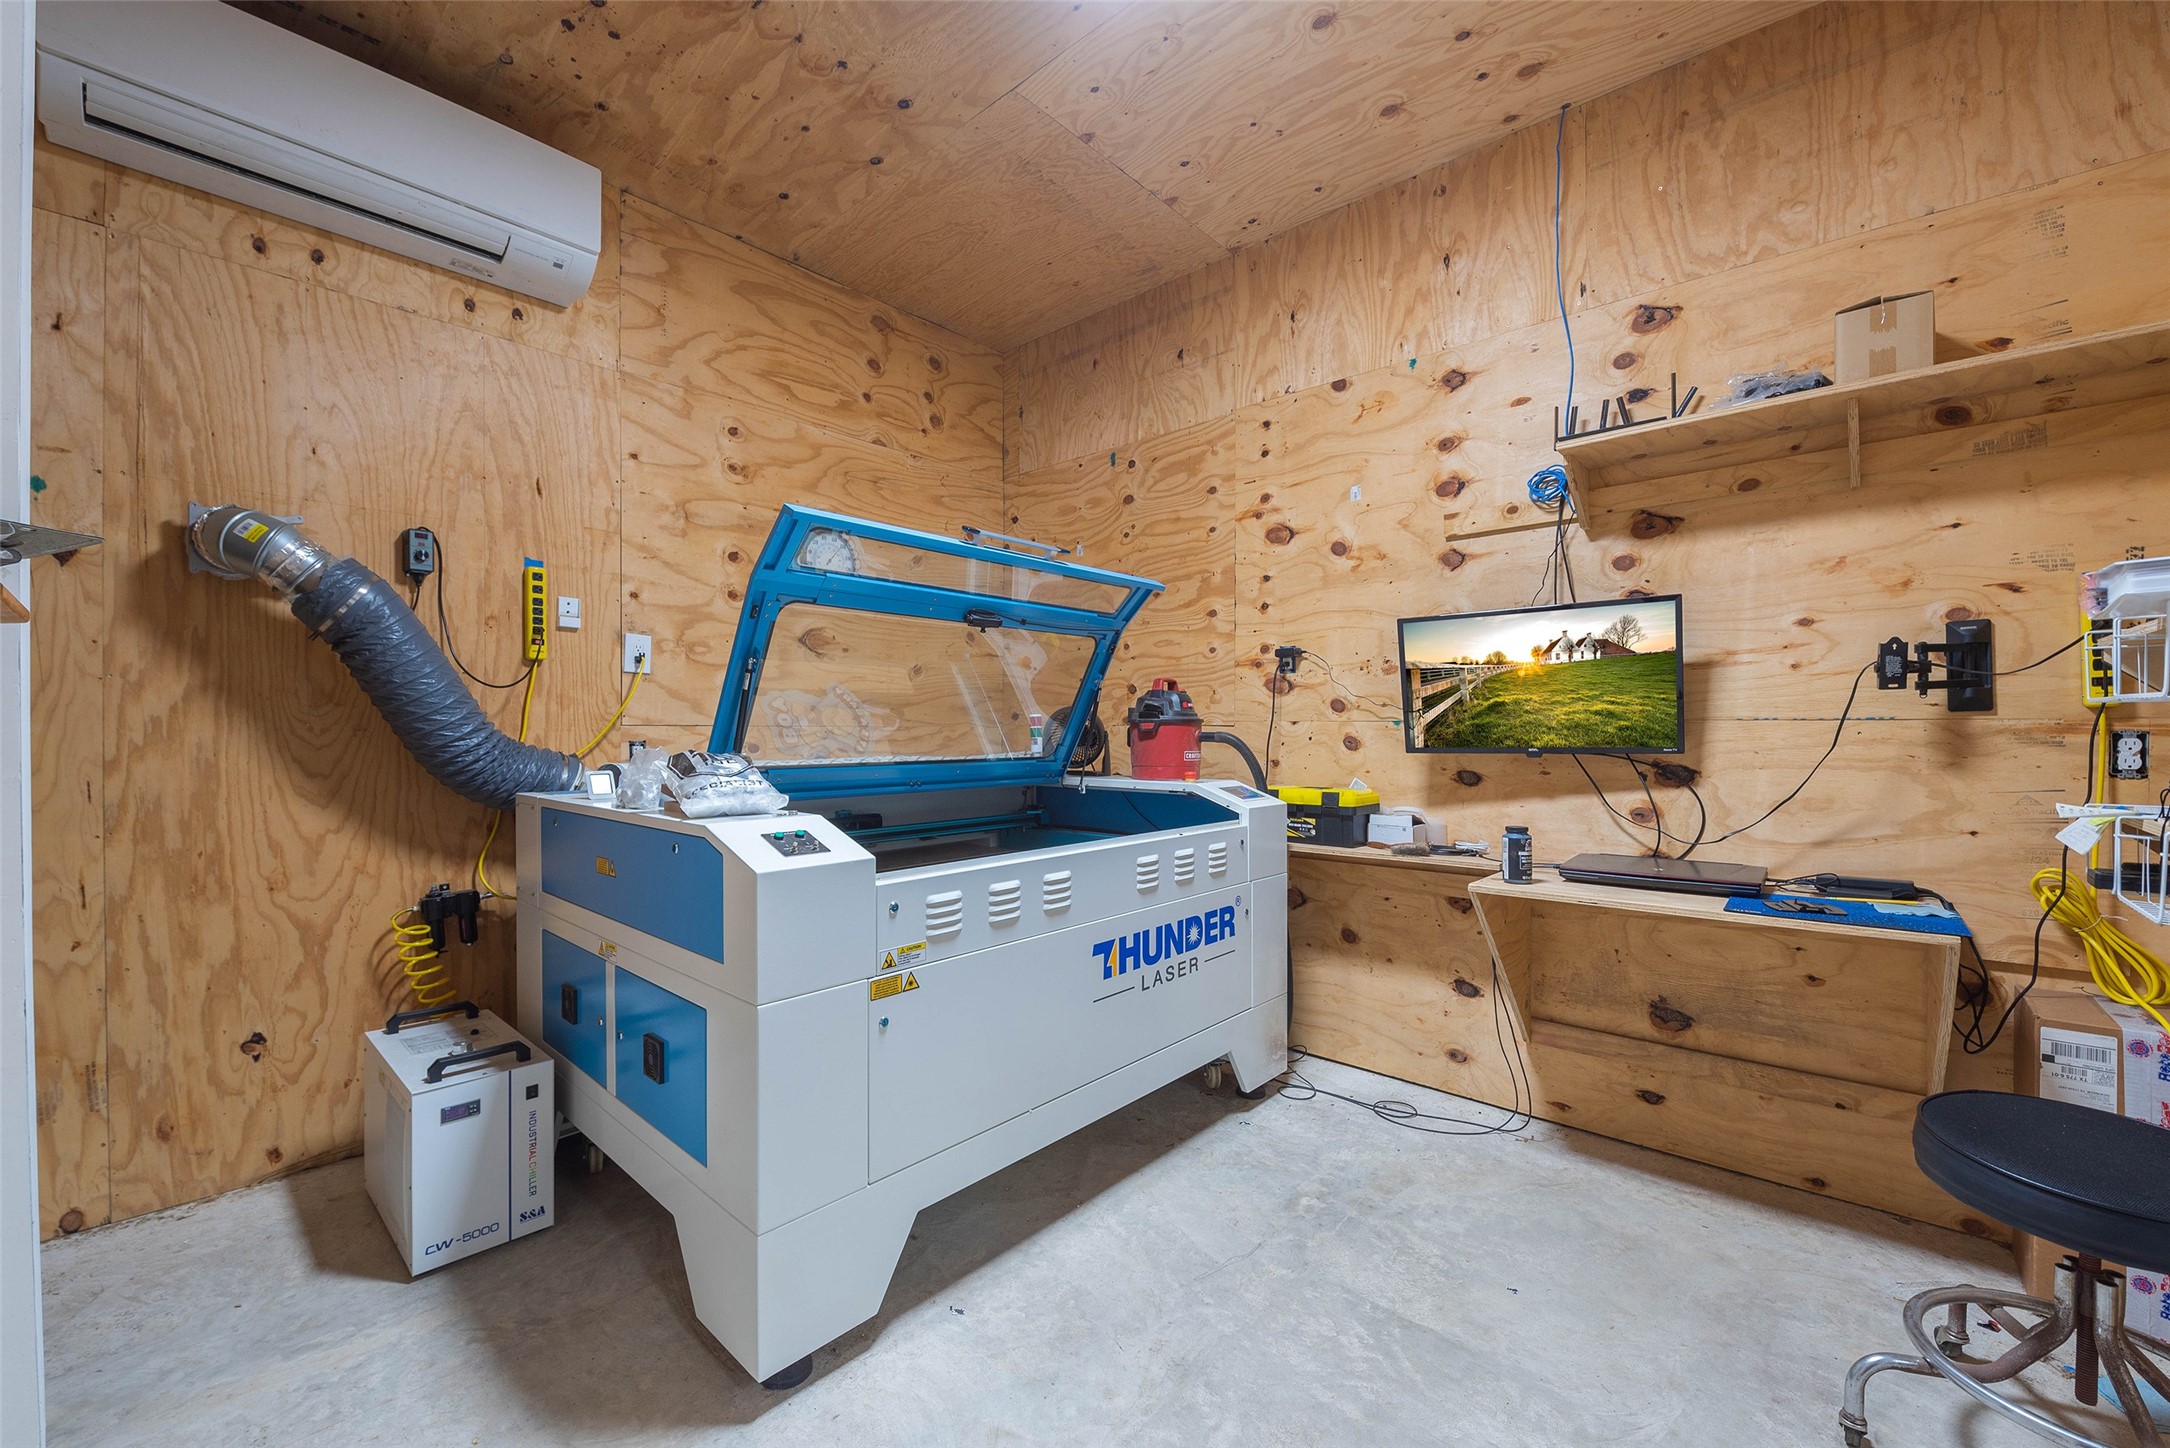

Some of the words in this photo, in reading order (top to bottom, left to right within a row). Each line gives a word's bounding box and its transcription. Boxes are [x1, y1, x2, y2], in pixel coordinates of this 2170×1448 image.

[1092, 905, 1236, 980] THUNDER
[1141, 956, 1199, 991] LASER
[528, 1109, 537, 1161] INDUSTRIAL
[528, 1161, 537, 1198] CHILLER
[519, 1205, 546, 1222] S&A
[425, 1222, 500, 1256] CW-5000
